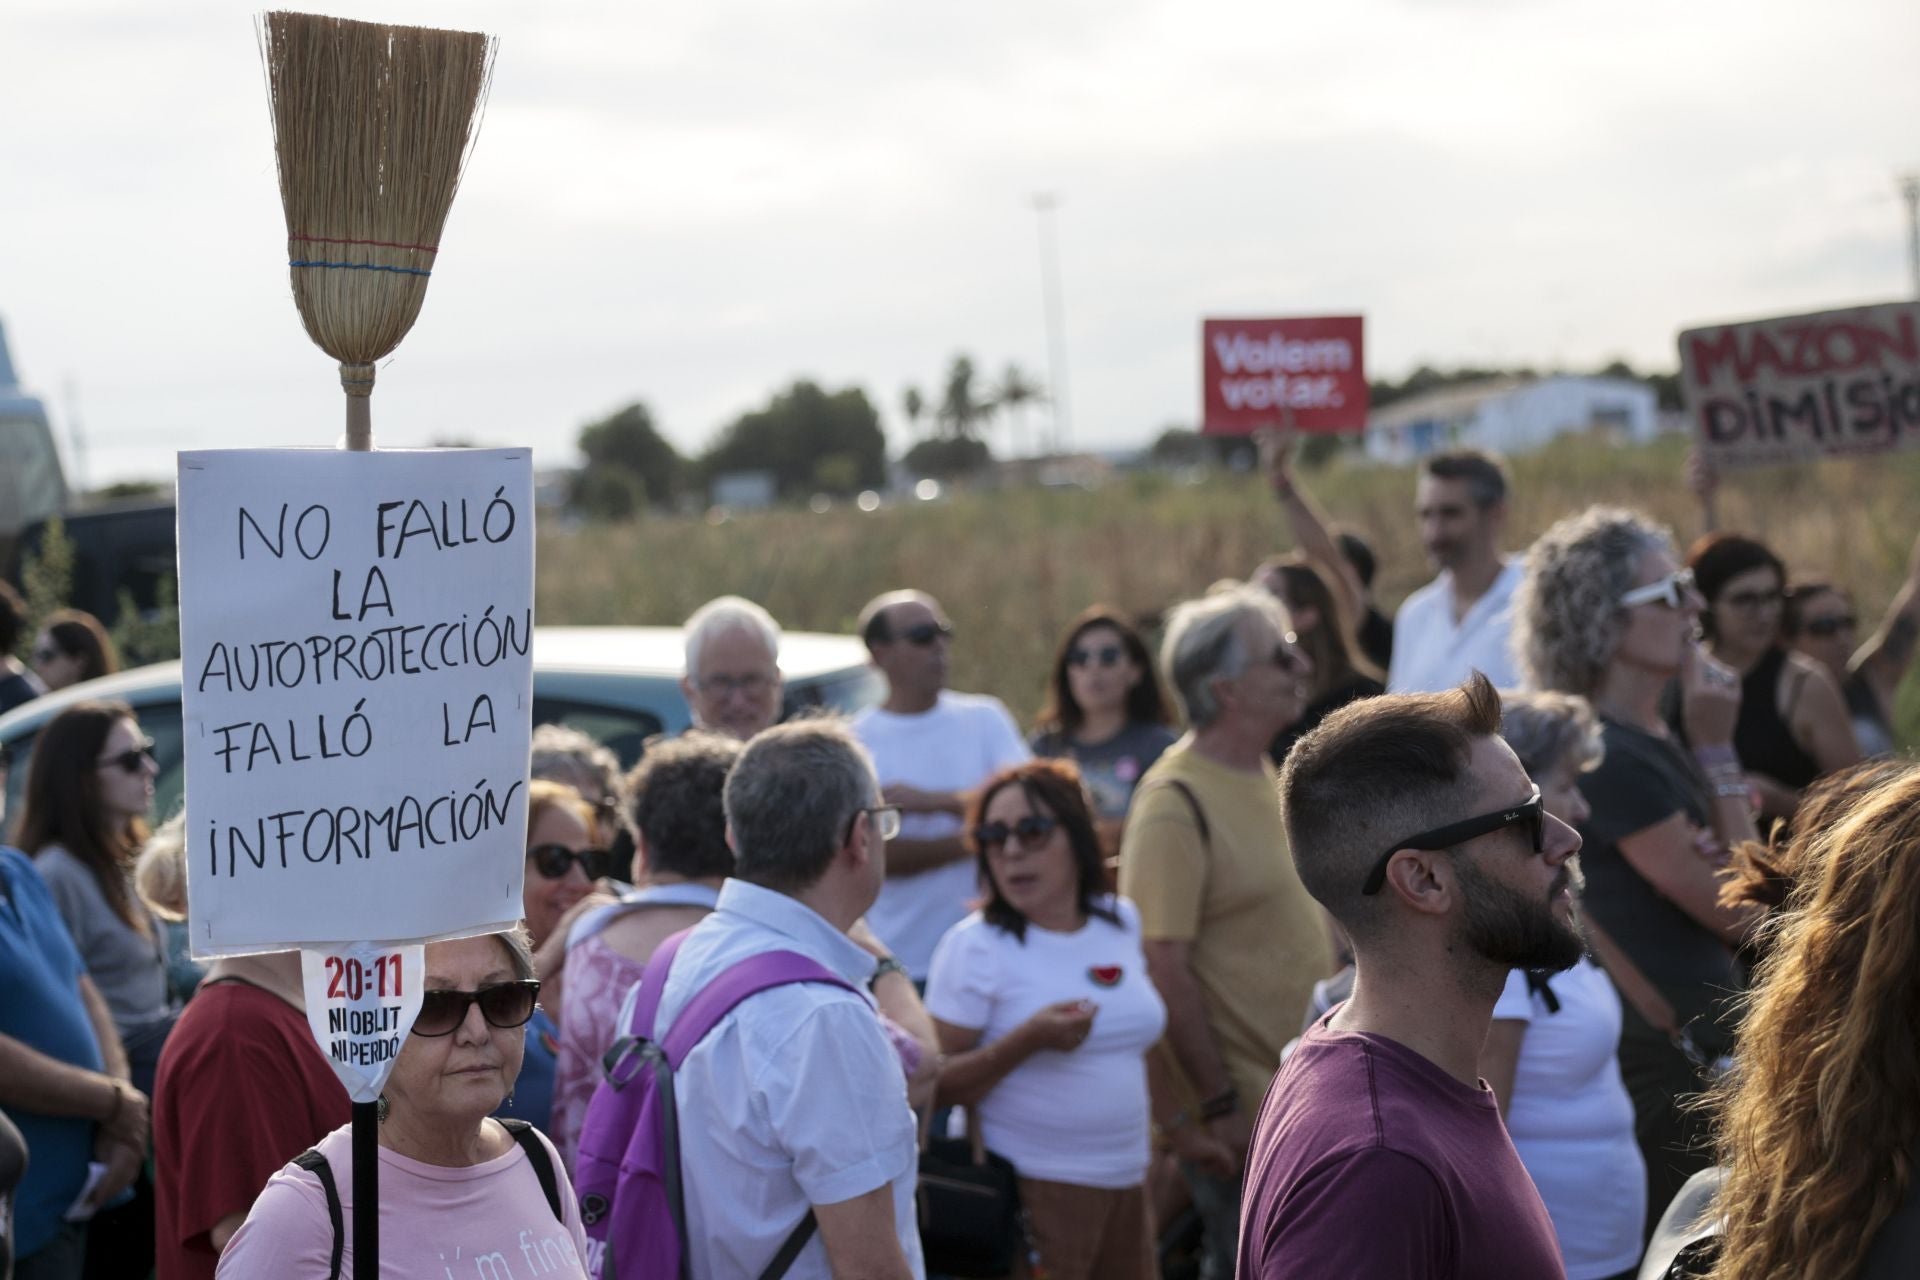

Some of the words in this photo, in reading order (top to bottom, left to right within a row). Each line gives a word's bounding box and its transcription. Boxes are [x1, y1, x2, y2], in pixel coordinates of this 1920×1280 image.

[1213, 330, 1353, 374] Volem
[1219, 369, 1345, 411] votar.
[239, 503, 330, 560] NO
[376, 486, 515, 559] FALLÓ
[332, 565, 394, 621] LA
[213, 698, 372, 773] FALLÓ
[443, 694, 496, 746] LA
[325, 953, 402, 1001] 20:11
[328, 1007, 347, 1034] NI
[350, 1006, 402, 1035] OBLIT
[331, 1039, 347, 1062] NI
